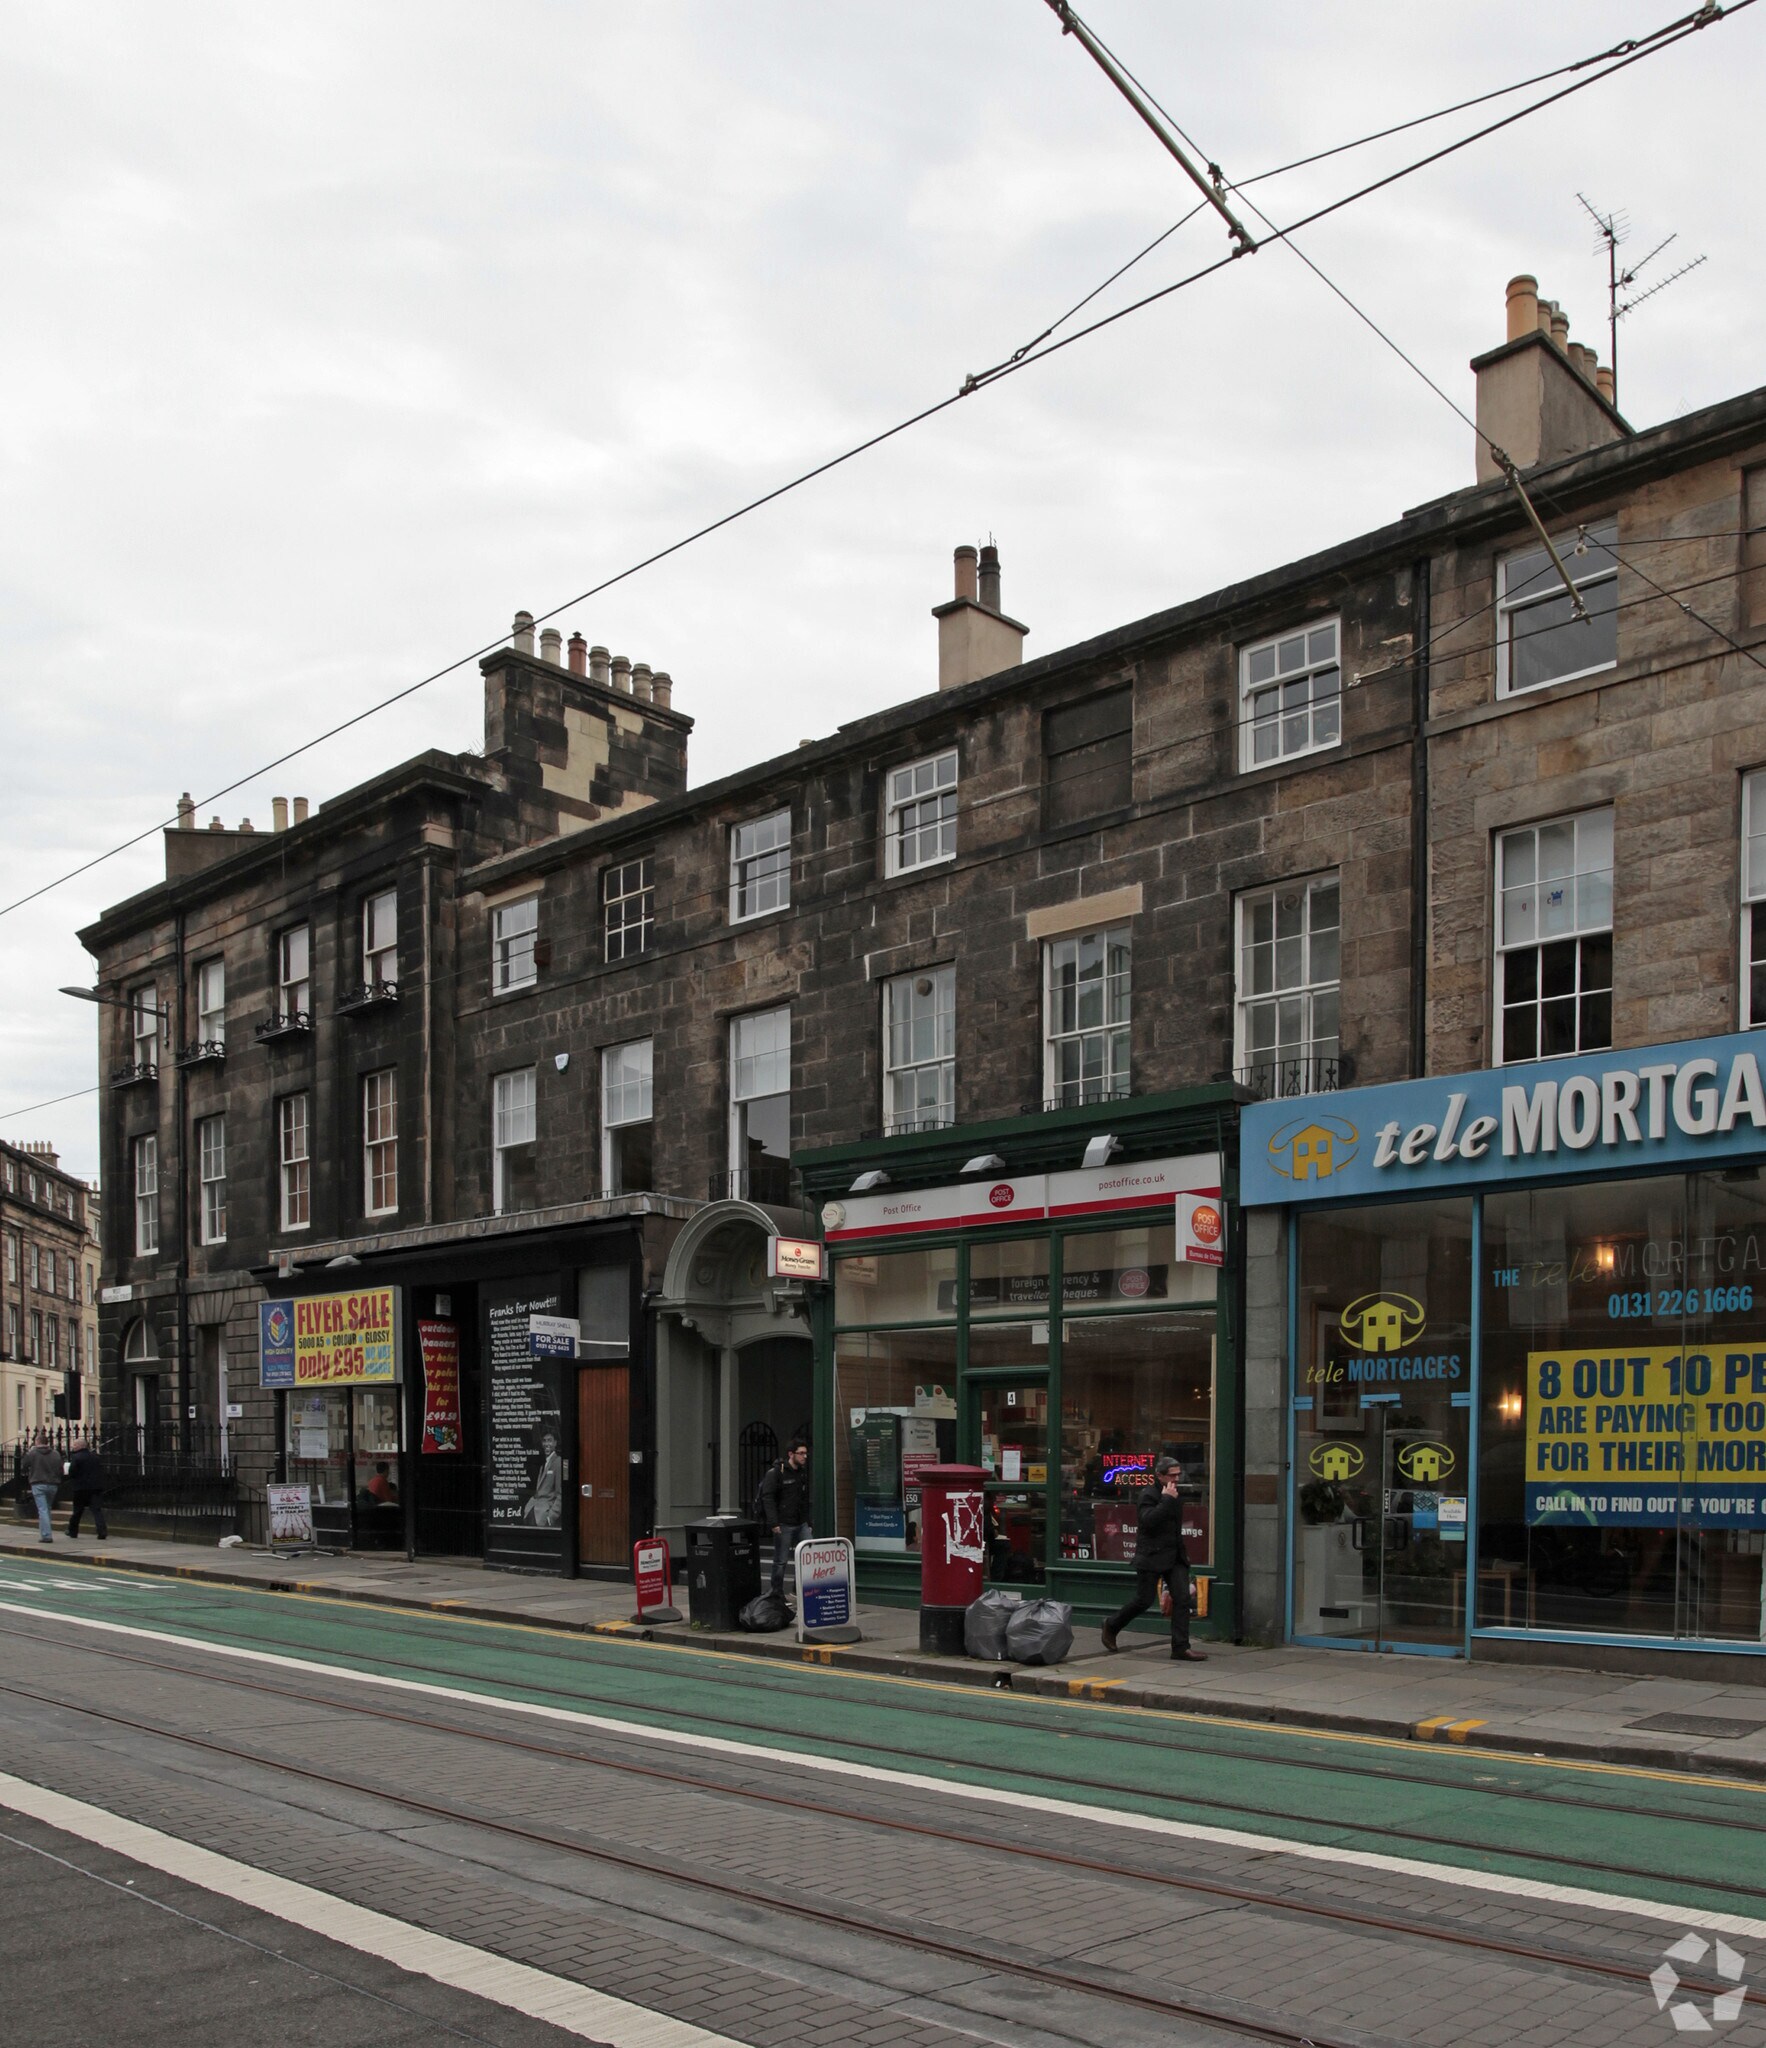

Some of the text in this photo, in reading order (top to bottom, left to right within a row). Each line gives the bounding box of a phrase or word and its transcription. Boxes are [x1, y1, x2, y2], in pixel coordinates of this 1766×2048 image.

[1373, 1053, 1766, 1168] tele MORTGA
[1098, 1173, 1165, 1192] postoffice.co.uk
[991, 1194, 1012, 1203] OFFICE
[994, 1188, 1009, 1197] POST
[883, 1203, 922, 1215] Post Office
[1197, 1212, 1216, 1227] POST
[1194, 1223, 1219, 1237] OFFICE
[1209, 1253, 1223, 1263] Chang
[1011, 1272, 1100, 1290] foreign crency &
[1126, 1275, 1143, 1284] POST
[1493, 1268, 1520, 1287] THE
[1122, 1281, 1146, 1291] OFFICE
[1010, 1288, 1099, 1302] traveller heques
[1608, 1285, 1753, 1319] 0131 226 1666
[298, 1300, 344, 1336] FLYER
[347, 1294, 390, 1331] SALE
[489, 1304, 514, 1319] Franks
[515, 1302, 527, 1314] for
[421, 1323, 456, 1334] outdoor
[298, 1330, 390, 1349] 5000 A5 COLOUR GLOSSY
[423, 1338, 456, 1349] banners
[536, 1334, 552, 1344] FOR
[552, 1337, 570, 1346] SALE
[300, 1346, 364, 1380] only £95
[1305, 1355, 1461, 1383] tele MORTGAGES
[1538, 1360, 1561, 1400] 8
[1573, 1357, 1651, 1400] OUT
[1663, 1355, 1712, 1396] 10
[428, 1382, 441, 1392] his
[1008, 1394, 1015, 1405] 4
[1538, 1401, 1765, 1435] ARE PAYING TOO
[1103, 1454, 1155, 1467] INTERNET
[1537, 1441, 1589, 1472] FOR
[1599, 1440, 1686, 1472] THEIR
[1115, 1473, 1155, 1486] ACCESS
[906, 1494, 918, 1503] £50
[1535, 1496, 1755, 1514] CALL IN TO FIND OUT IF YOU'RE
[493, 1505, 522, 1518] the End
[1122, 1524, 1203, 1537] Bur ange
[802, 1549, 847, 1566] ID PHOTOS
[1078, 1548, 1089, 1559] ID
[812, 1566, 836, 1580] Here
